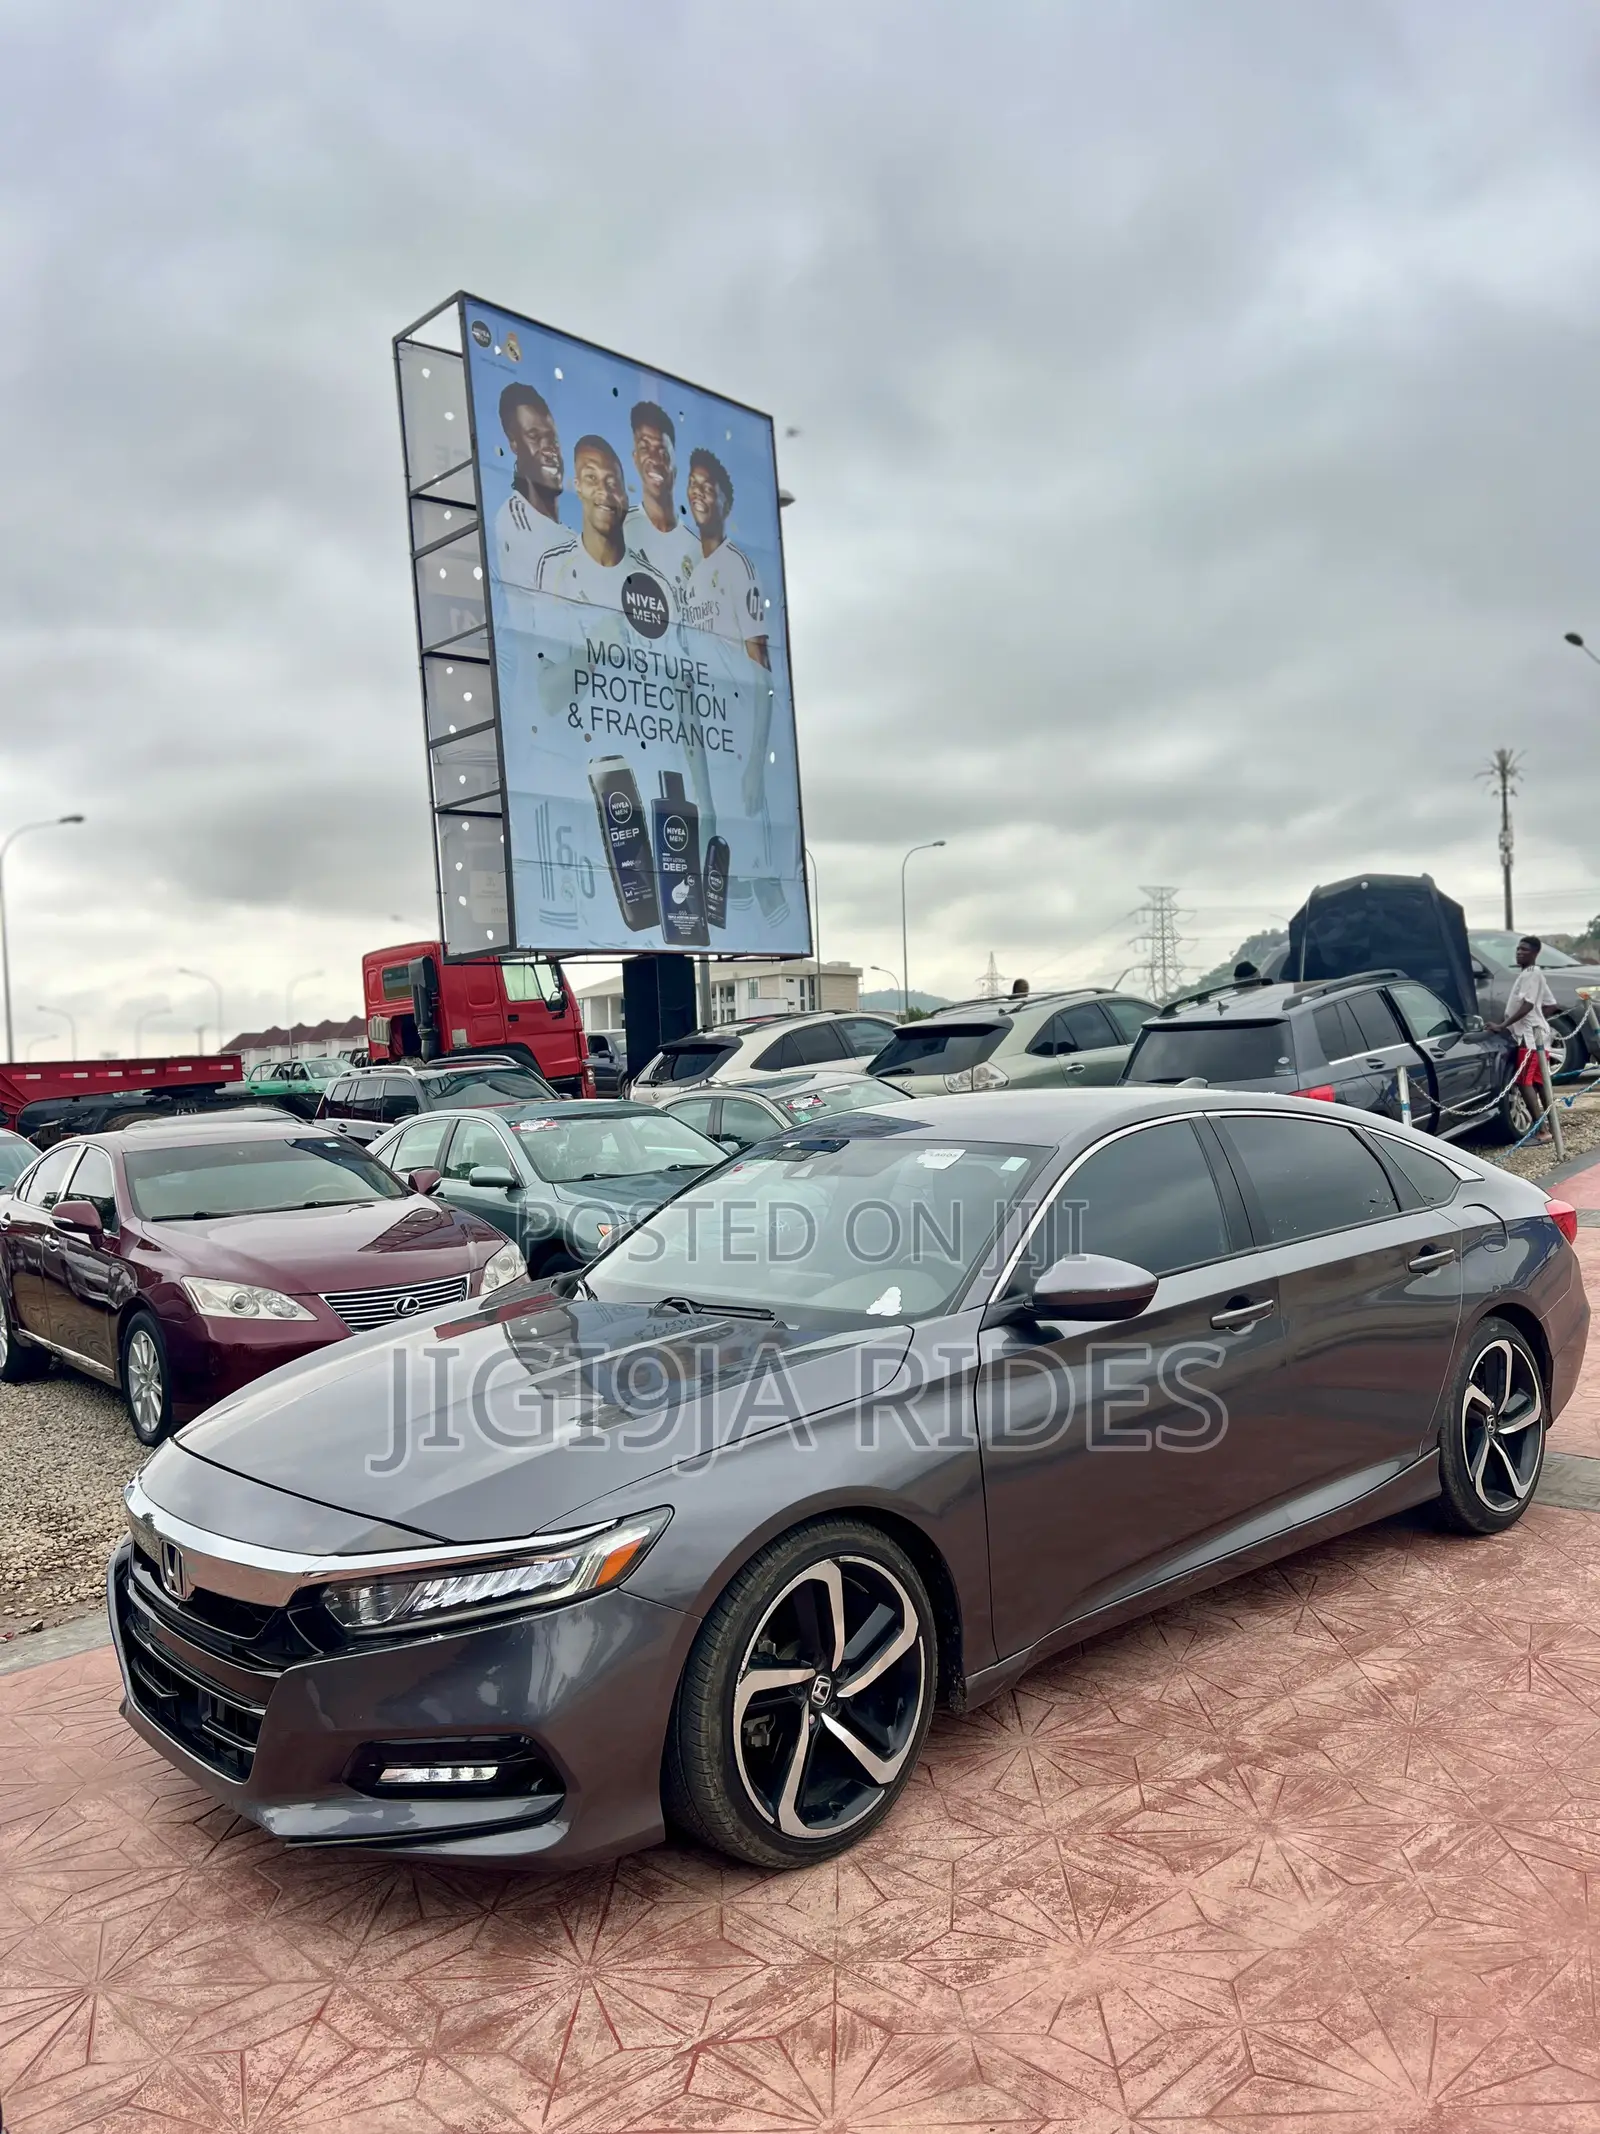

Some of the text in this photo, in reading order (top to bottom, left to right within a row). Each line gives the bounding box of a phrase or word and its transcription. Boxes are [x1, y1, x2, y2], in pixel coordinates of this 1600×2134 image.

[626, 591, 666, 613] NIVEA
[632, 607, 662, 625] MEN
[586, 638, 715, 692] MOISTURE,
[574, 669, 727, 721] PROTECTION
[568, 702, 735, 753] & FRAGRANCE
[611, 801, 629, 810] NIVEA
[610, 828, 640, 841] DEEP
[666, 827, 686, 836] NIVEA
[662, 862, 688, 872] DEEP
